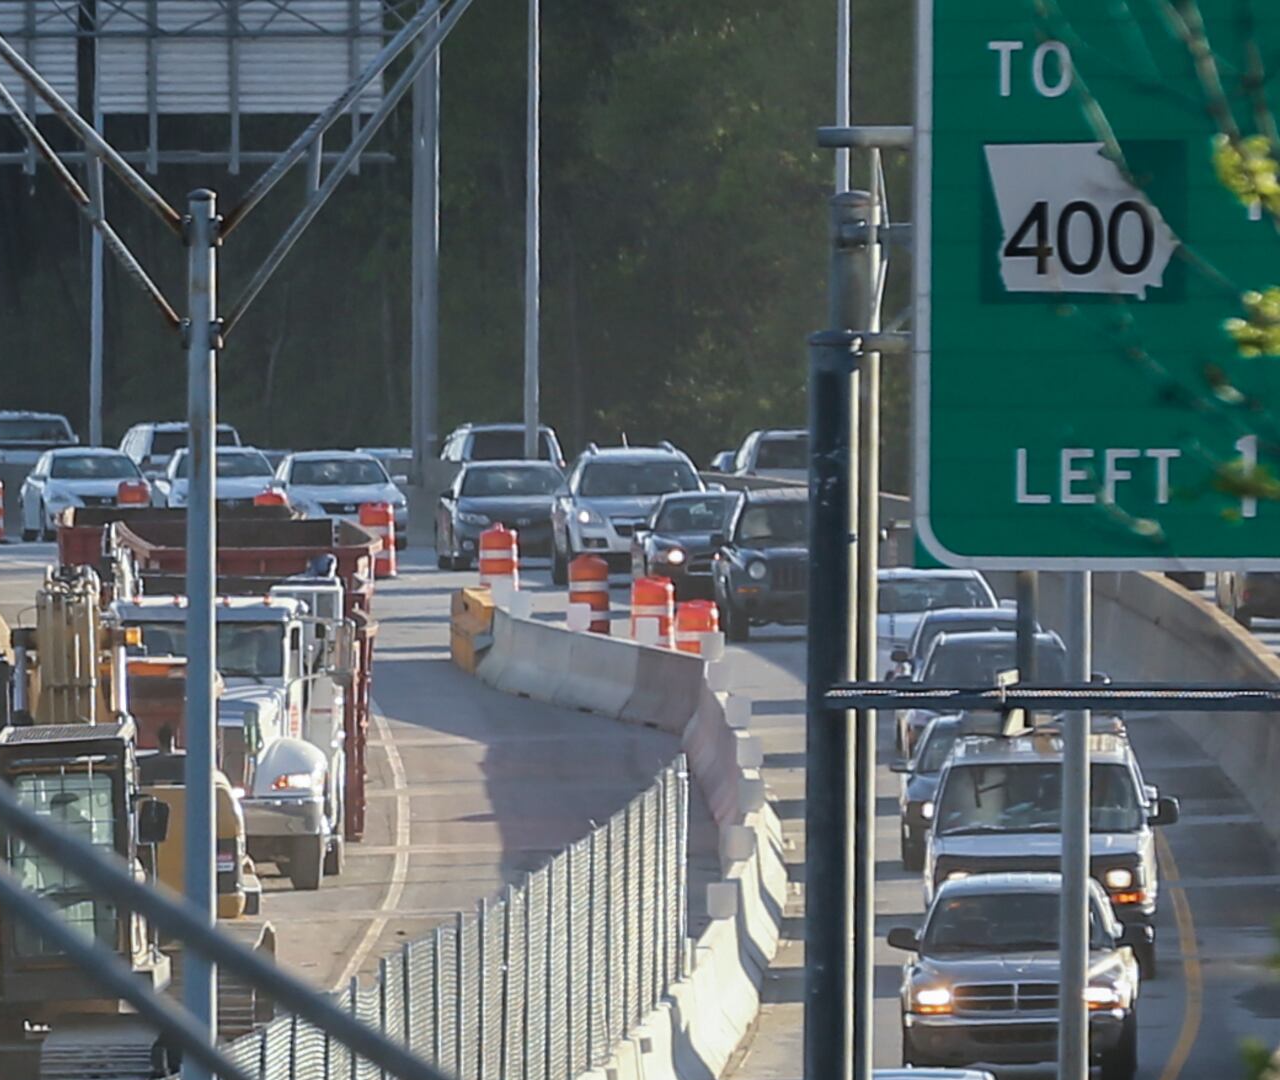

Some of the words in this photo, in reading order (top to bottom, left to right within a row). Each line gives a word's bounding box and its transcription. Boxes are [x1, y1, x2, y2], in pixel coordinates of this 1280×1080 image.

[987, 41, 1073, 97] TO
[1003, 200, 1155, 275] 400
[1016, 448, 1181, 504] LEFT
